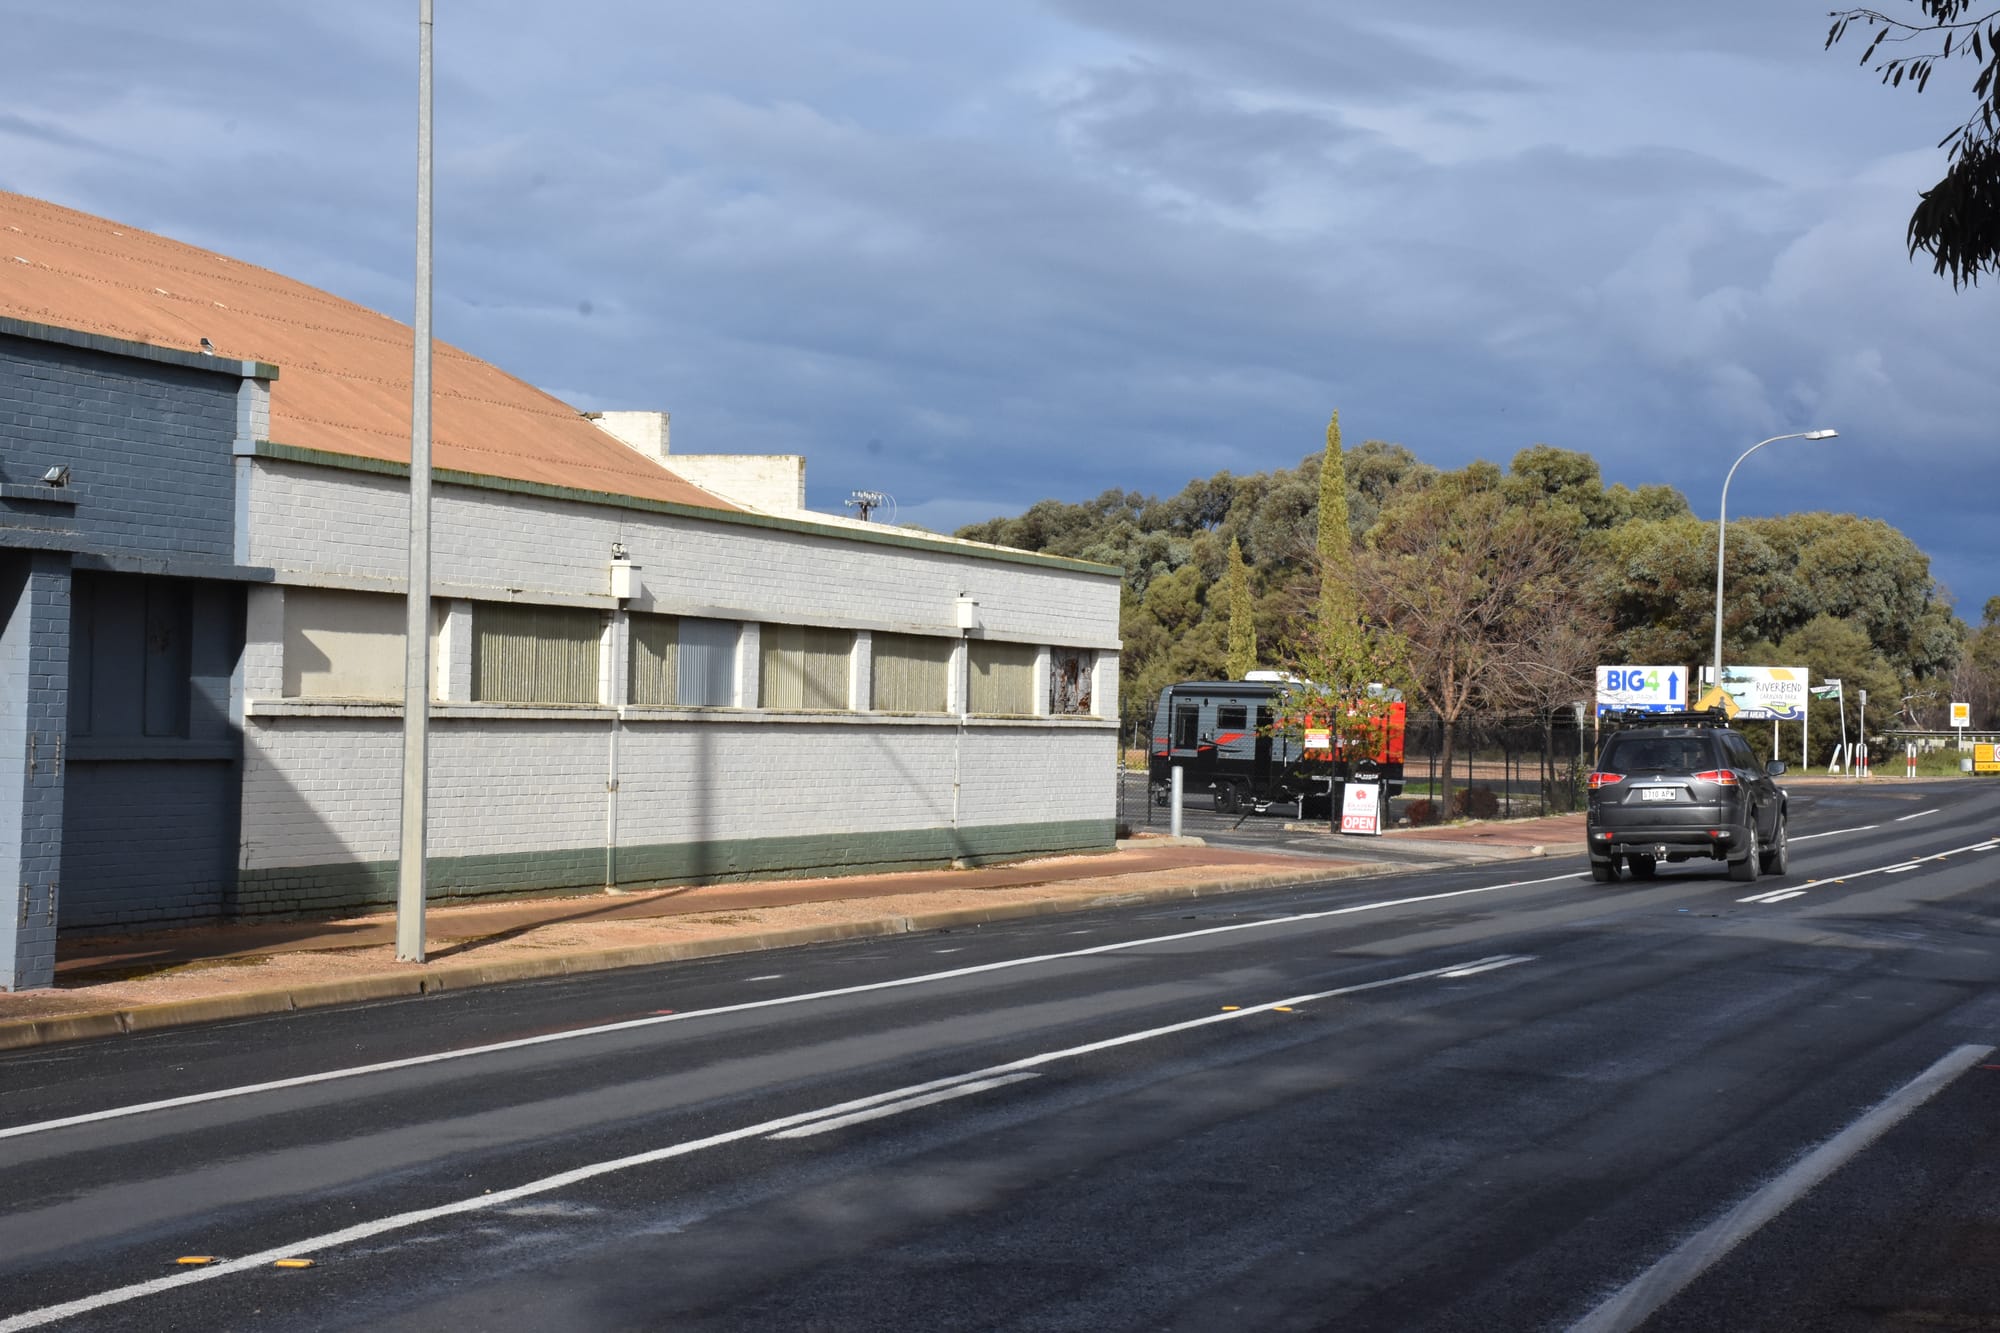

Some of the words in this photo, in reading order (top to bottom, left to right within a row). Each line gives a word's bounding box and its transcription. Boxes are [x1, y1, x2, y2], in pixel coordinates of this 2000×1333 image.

[1607, 670, 1660, 691] BIG4
[1756, 682, 1802, 694] RIVERBEND
[1343, 816, 1374, 829] OPEN
